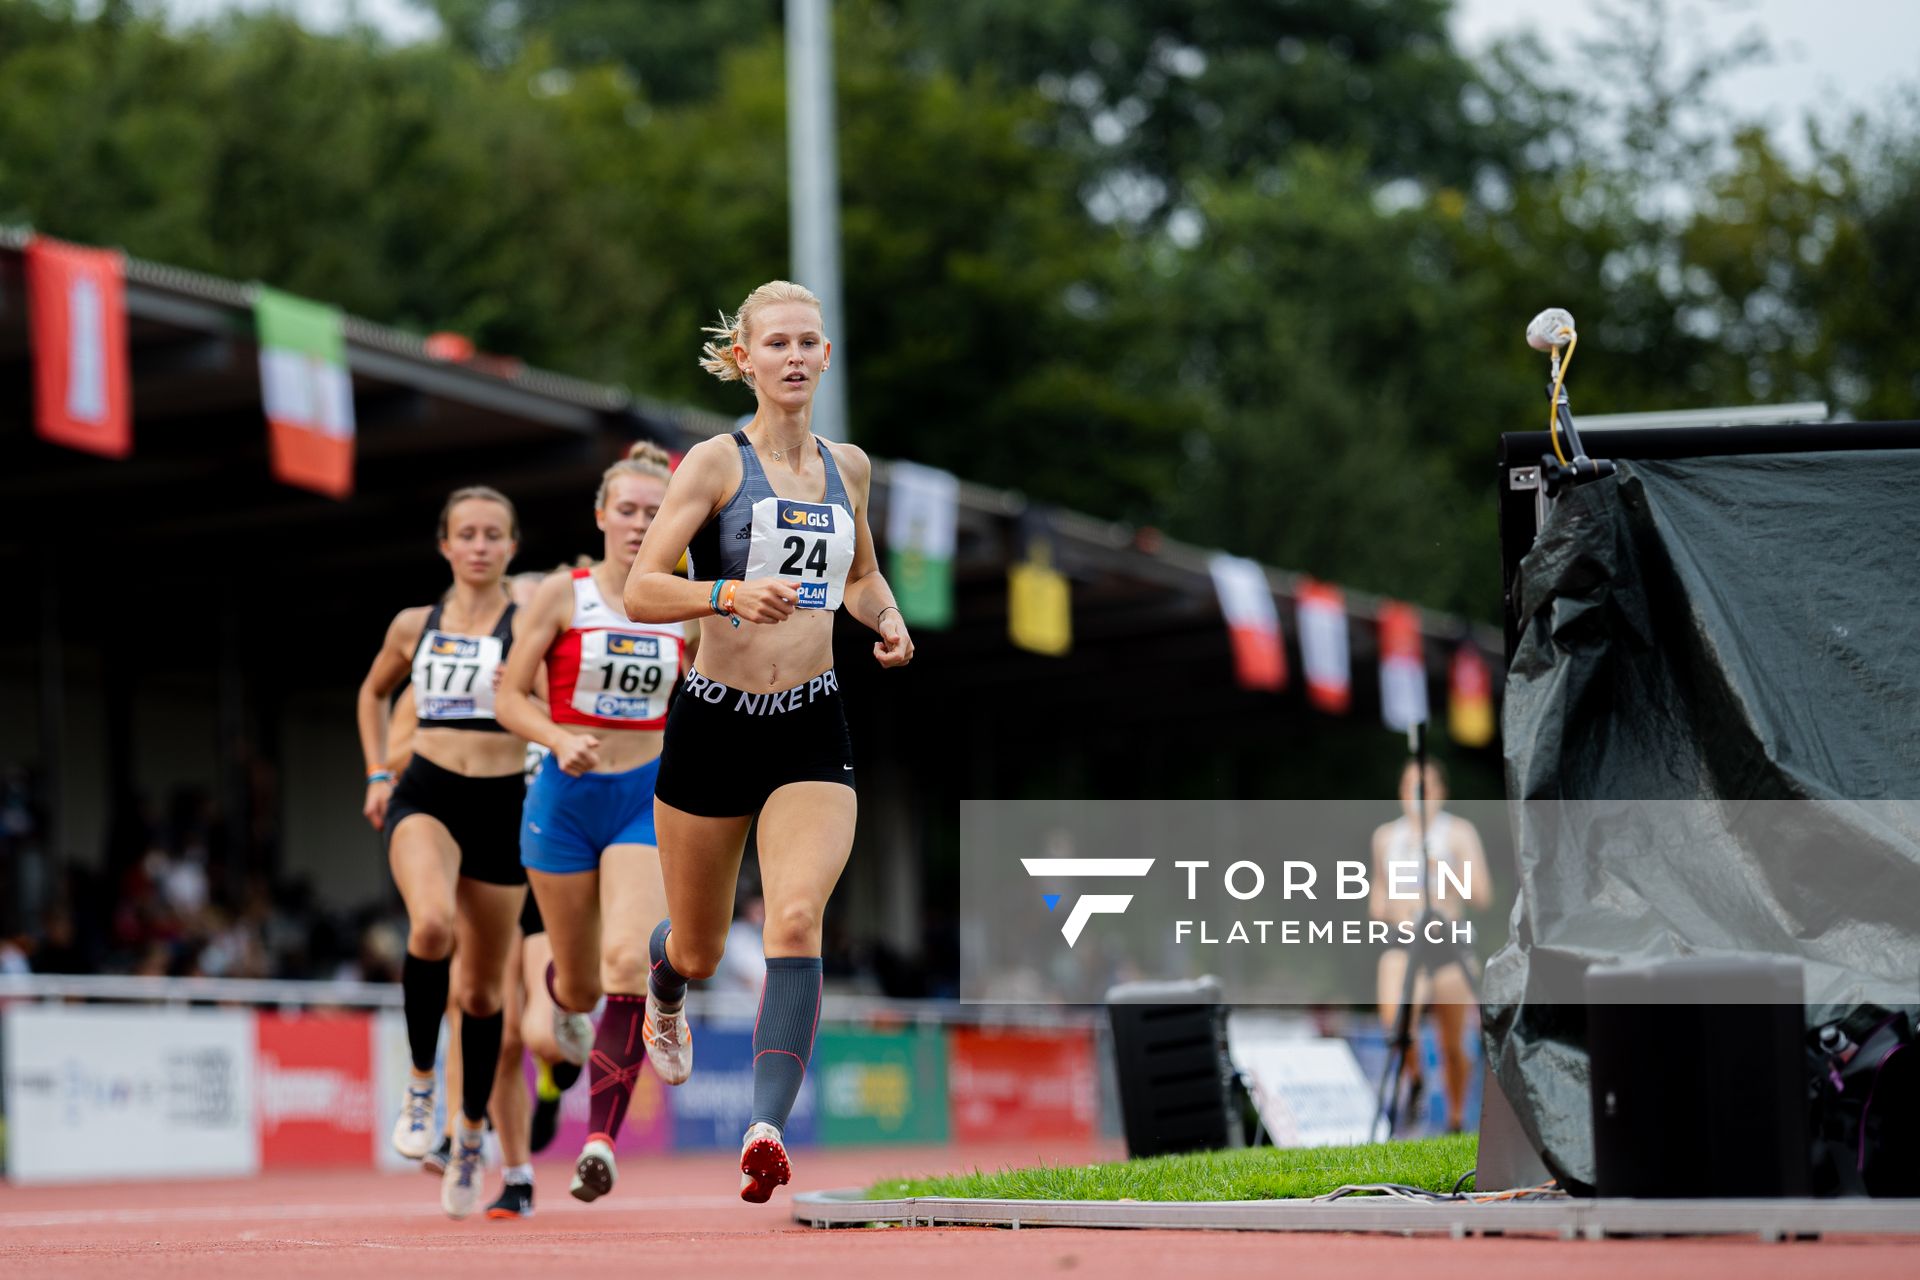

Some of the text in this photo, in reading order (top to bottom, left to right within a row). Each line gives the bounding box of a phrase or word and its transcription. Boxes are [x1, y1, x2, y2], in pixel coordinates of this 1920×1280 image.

[807, 513, 829, 527] GLS
[779, 535, 828, 578] 24
[797, 587, 825, 599] PLAN
[425, 661, 480, 693] 177
[600, 662, 662, 694] 169
[686, 666, 839, 716] PRO NIKE PR
